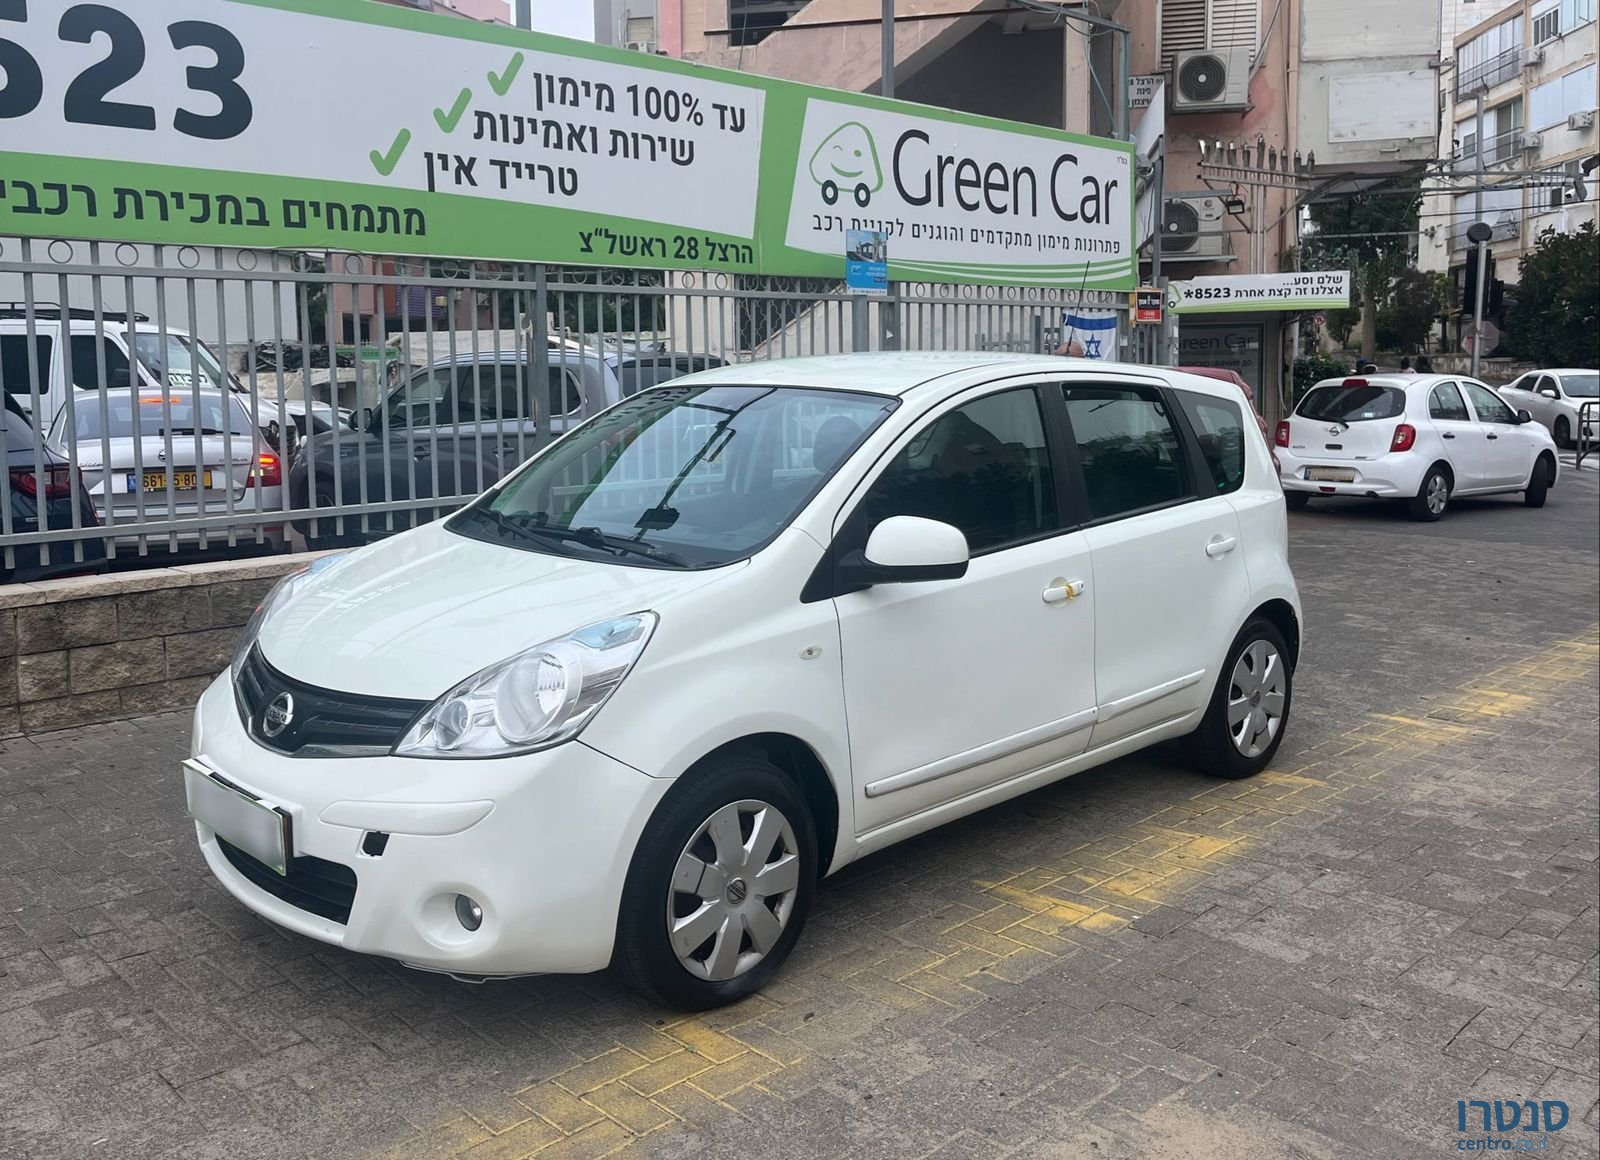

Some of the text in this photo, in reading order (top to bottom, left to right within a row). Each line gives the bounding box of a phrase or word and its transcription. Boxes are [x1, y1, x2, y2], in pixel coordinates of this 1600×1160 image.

[532, 71, 747, 133] עד 100% מימון
[472, 109, 695, 167] שירות ואמינות
[423, 150, 579, 197] טרייד אין
[892, 128, 1118, 226] Green Car
[112, 186, 271, 227] במכירת
[282, 198, 427, 236] מתמחים
[812, 213, 844, 233] רכב
[911, 223, 964, 242] והוגנים
[673, 234, 699, 260] 28
[704, 236, 753, 264] הרצל
[970, 229, 1033, 250] מתקדמים
[1037, 232, 1070, 252] מימון
[1073, 233, 1121, 255] פתרונות
[1311, 285, 1343, 295] אצלנו
[1317, 274, 1343, 286] שלם
[1234, 289, 1265, 298] אחרת
[1268, 287, 1292, 299] קצת
[1294, 286, 1308, 296] זה
[1179, 333, 1254, 350] reen Car
